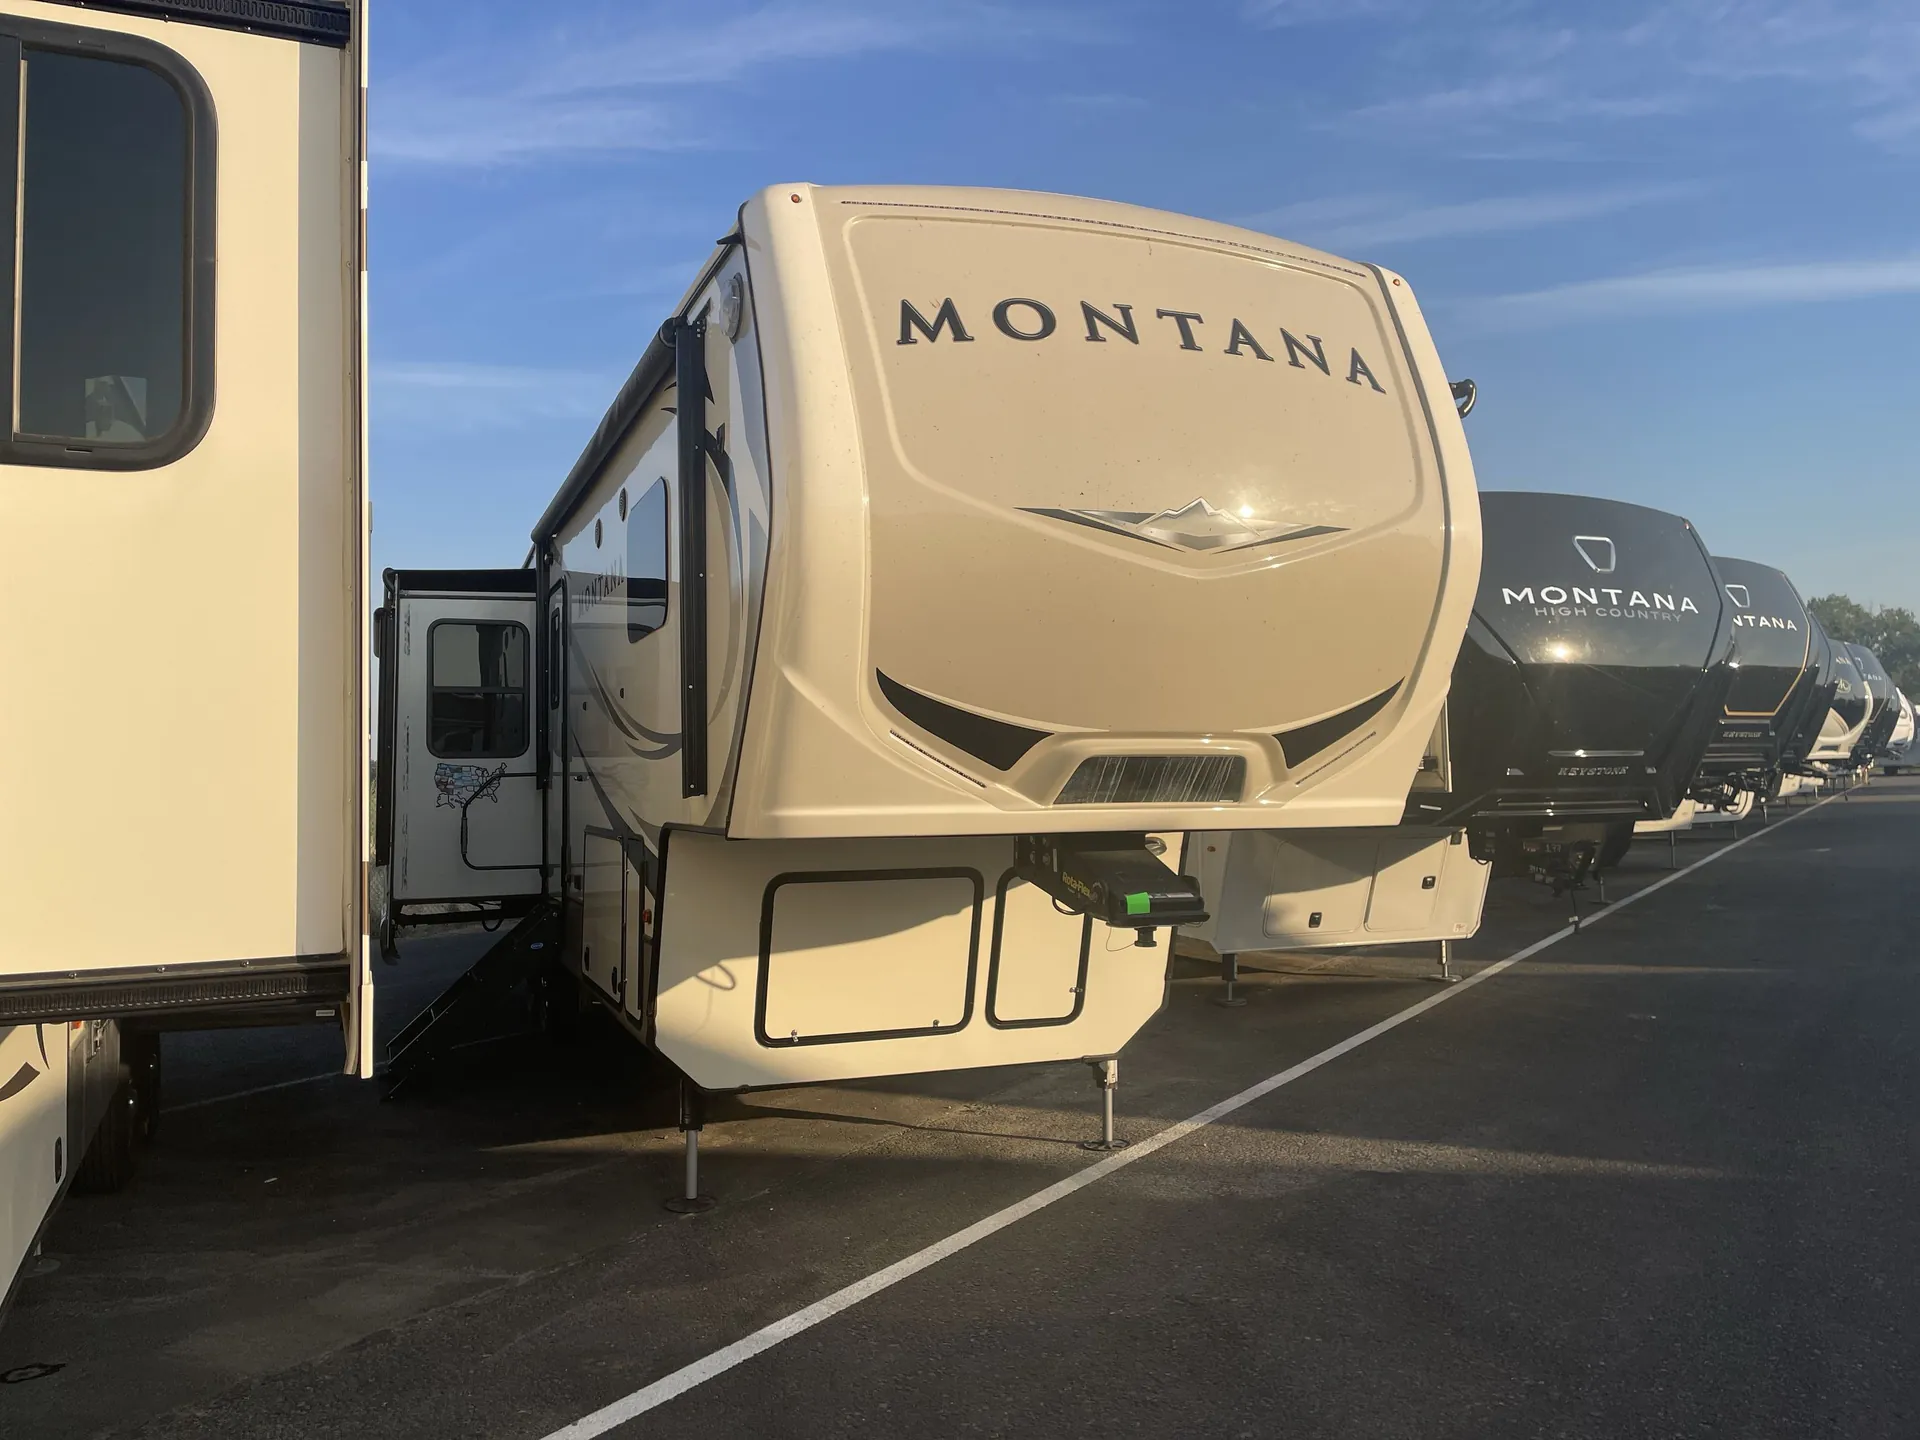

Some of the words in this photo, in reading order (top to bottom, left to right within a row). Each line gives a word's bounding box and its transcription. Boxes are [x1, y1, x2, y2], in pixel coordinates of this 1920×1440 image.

[896, 297, 1387, 395] MONTANA
[1501, 586, 1699, 614] MONTANA
[1534, 607, 1588, 616] HIGH
[1595, 608, 1682, 622] COUNTRY
[1557, 766, 1629, 776] KEYSTONE
